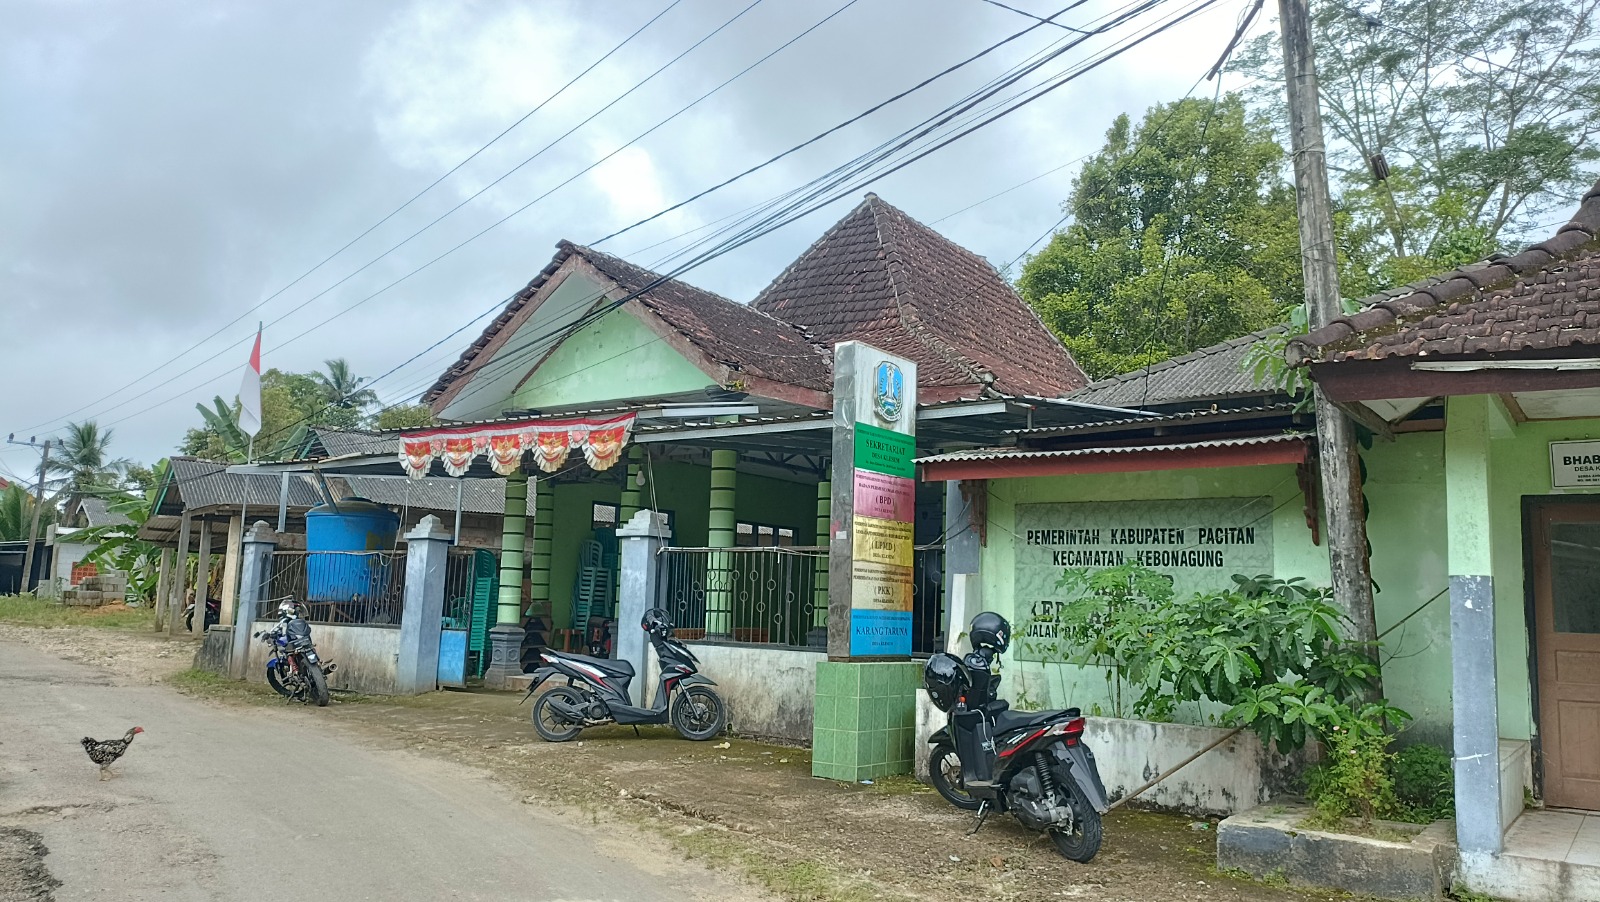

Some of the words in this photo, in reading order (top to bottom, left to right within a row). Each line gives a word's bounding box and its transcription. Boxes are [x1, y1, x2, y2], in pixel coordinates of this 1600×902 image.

[866, 439, 906, 455] SEKRETARIAT
[1110, 528, 1184, 544] KABUPATEN
[1198, 527, 1255, 544] PACITAN
[1053, 550, 1124, 566] KECAMATAN
[1136, 550, 1224, 567] KEBONAGUNG
[856, 626, 883, 636] KARANG
[885, 626, 908, 636] TARUNA
[1026, 624, 1058, 638] JALAN
